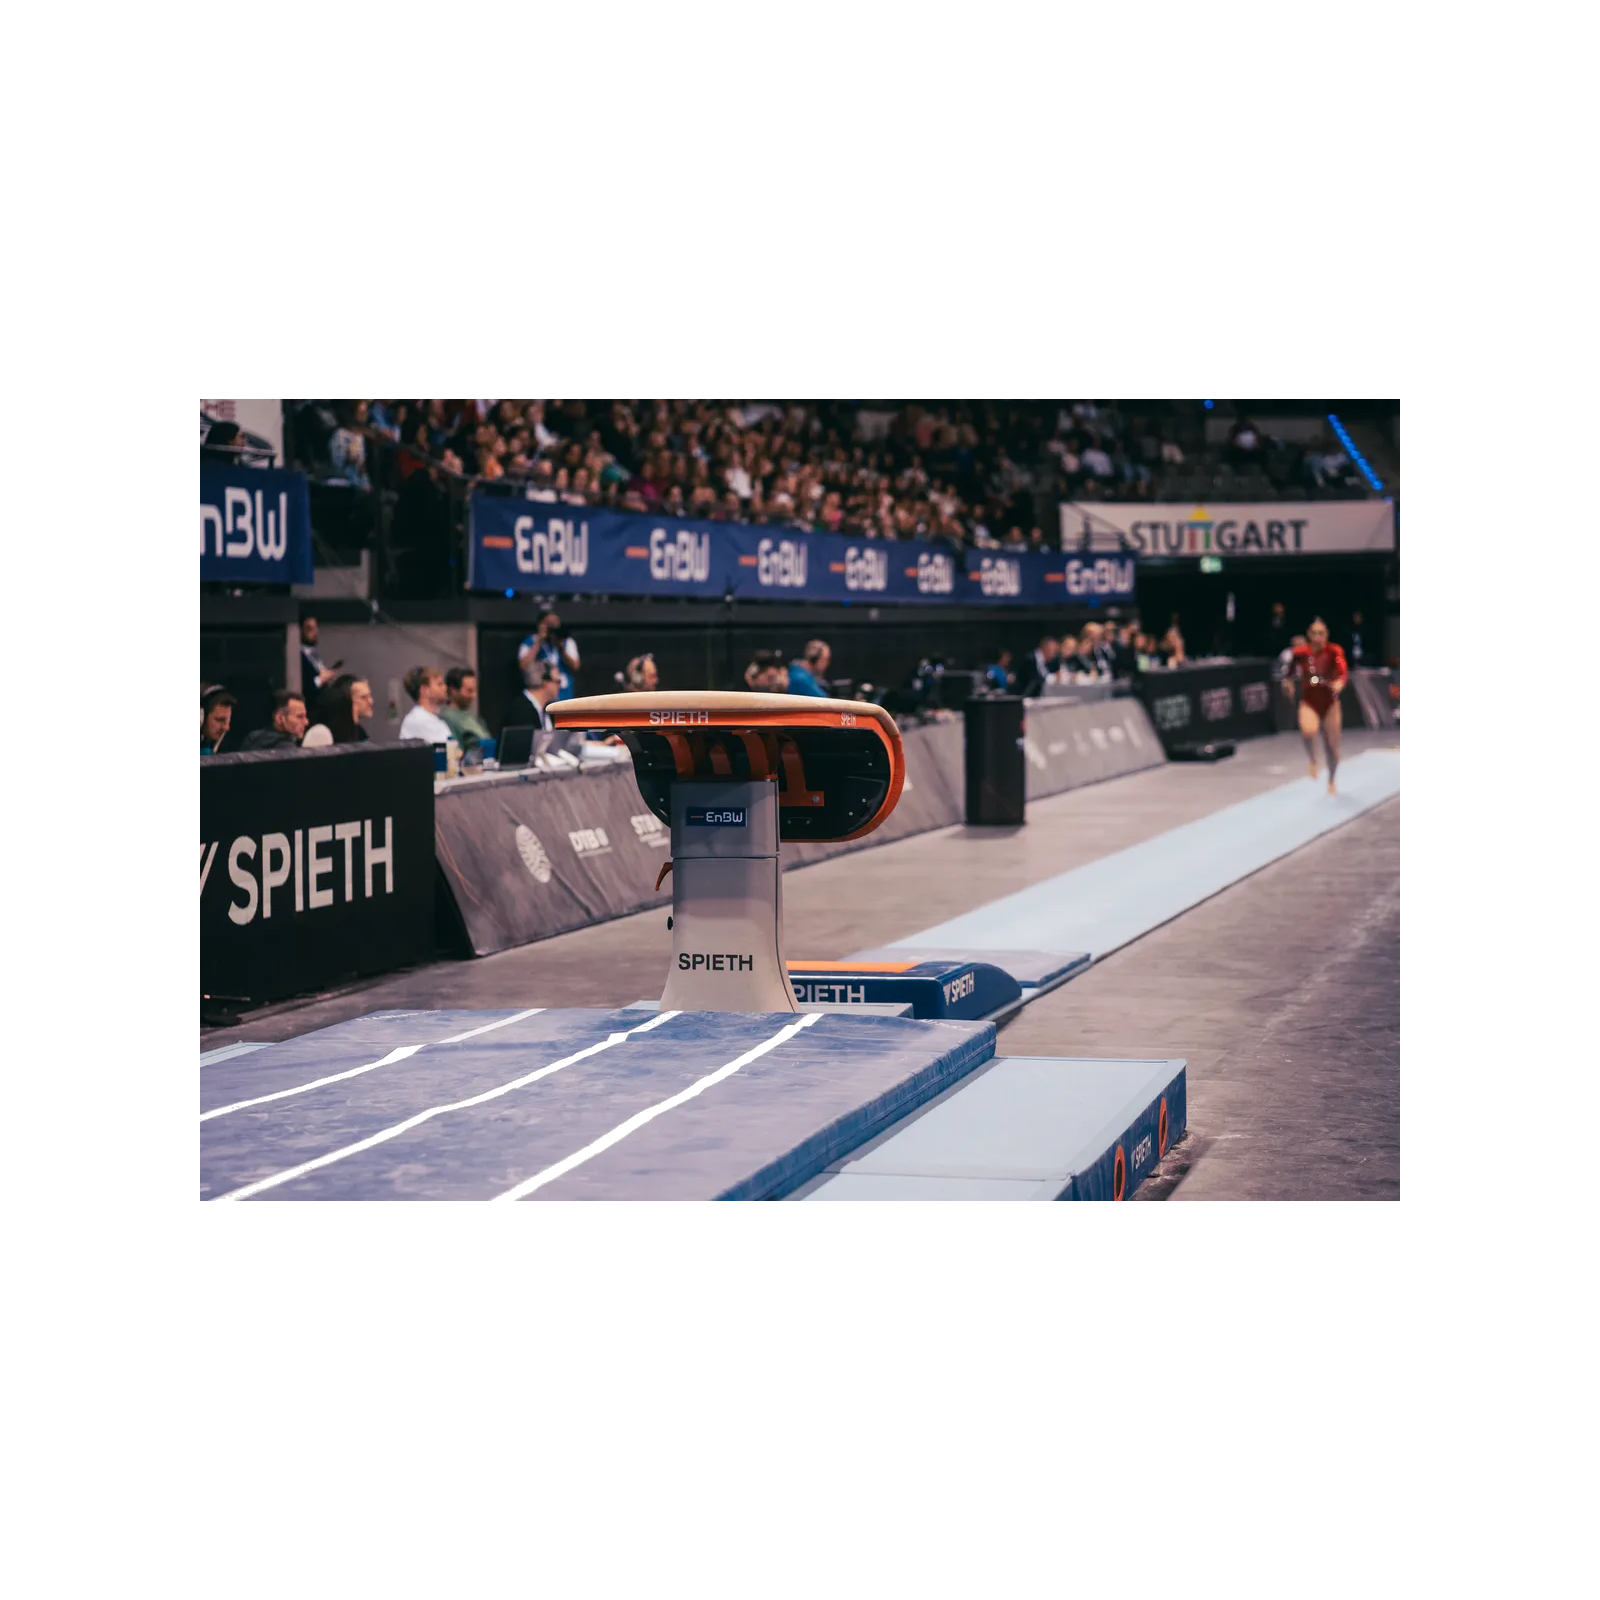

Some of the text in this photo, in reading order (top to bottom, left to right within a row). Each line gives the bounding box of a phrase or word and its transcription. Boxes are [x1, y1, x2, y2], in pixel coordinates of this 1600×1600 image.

[200, 486, 287, 561] nBW
[1131, 519, 1306, 551] STUTTGART
[515, 515, 588, 577] EnBW
[651, 528, 710, 582] EnBW
[649, 711, 709, 725] SPIETH
[706, 811, 743, 823] EnBW
[228, 816, 394, 925] SPIETH
[678, 953, 753, 971] SPIETH
[793, 985, 865, 1003] PIETH
[951, 971, 975, 1003] SPIETH
